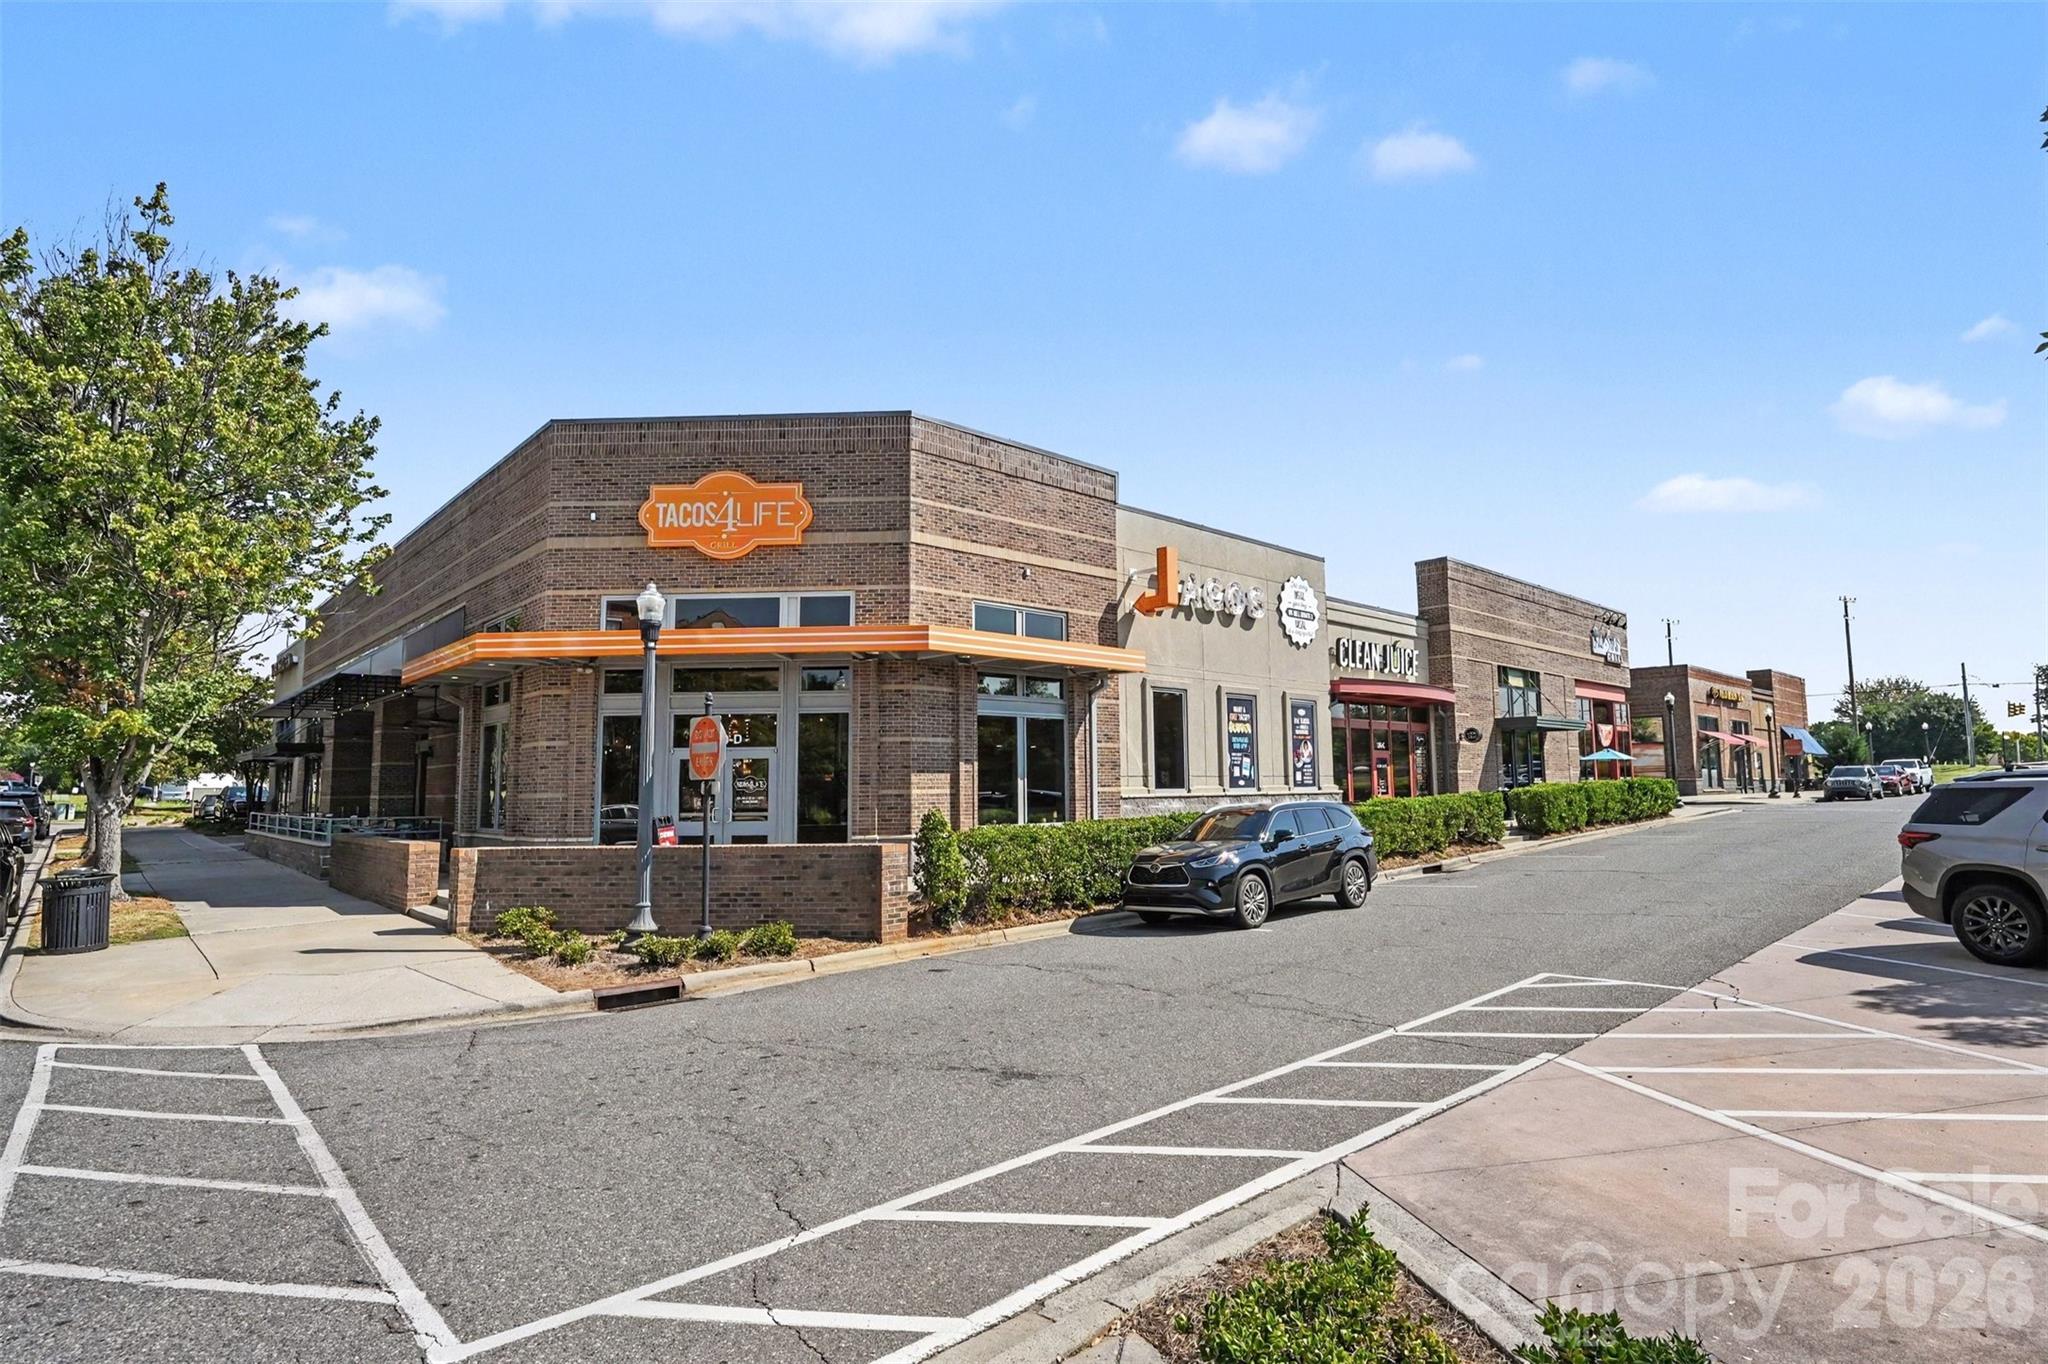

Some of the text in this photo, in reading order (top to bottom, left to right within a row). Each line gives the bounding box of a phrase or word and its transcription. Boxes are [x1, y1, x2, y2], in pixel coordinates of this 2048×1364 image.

[1339, 638, 1419, 677] CLEAN JUICE
[704, 728, 715, 738] NOT
[733, 734, 743, 745] D
[695, 756, 714, 768] ENTER
